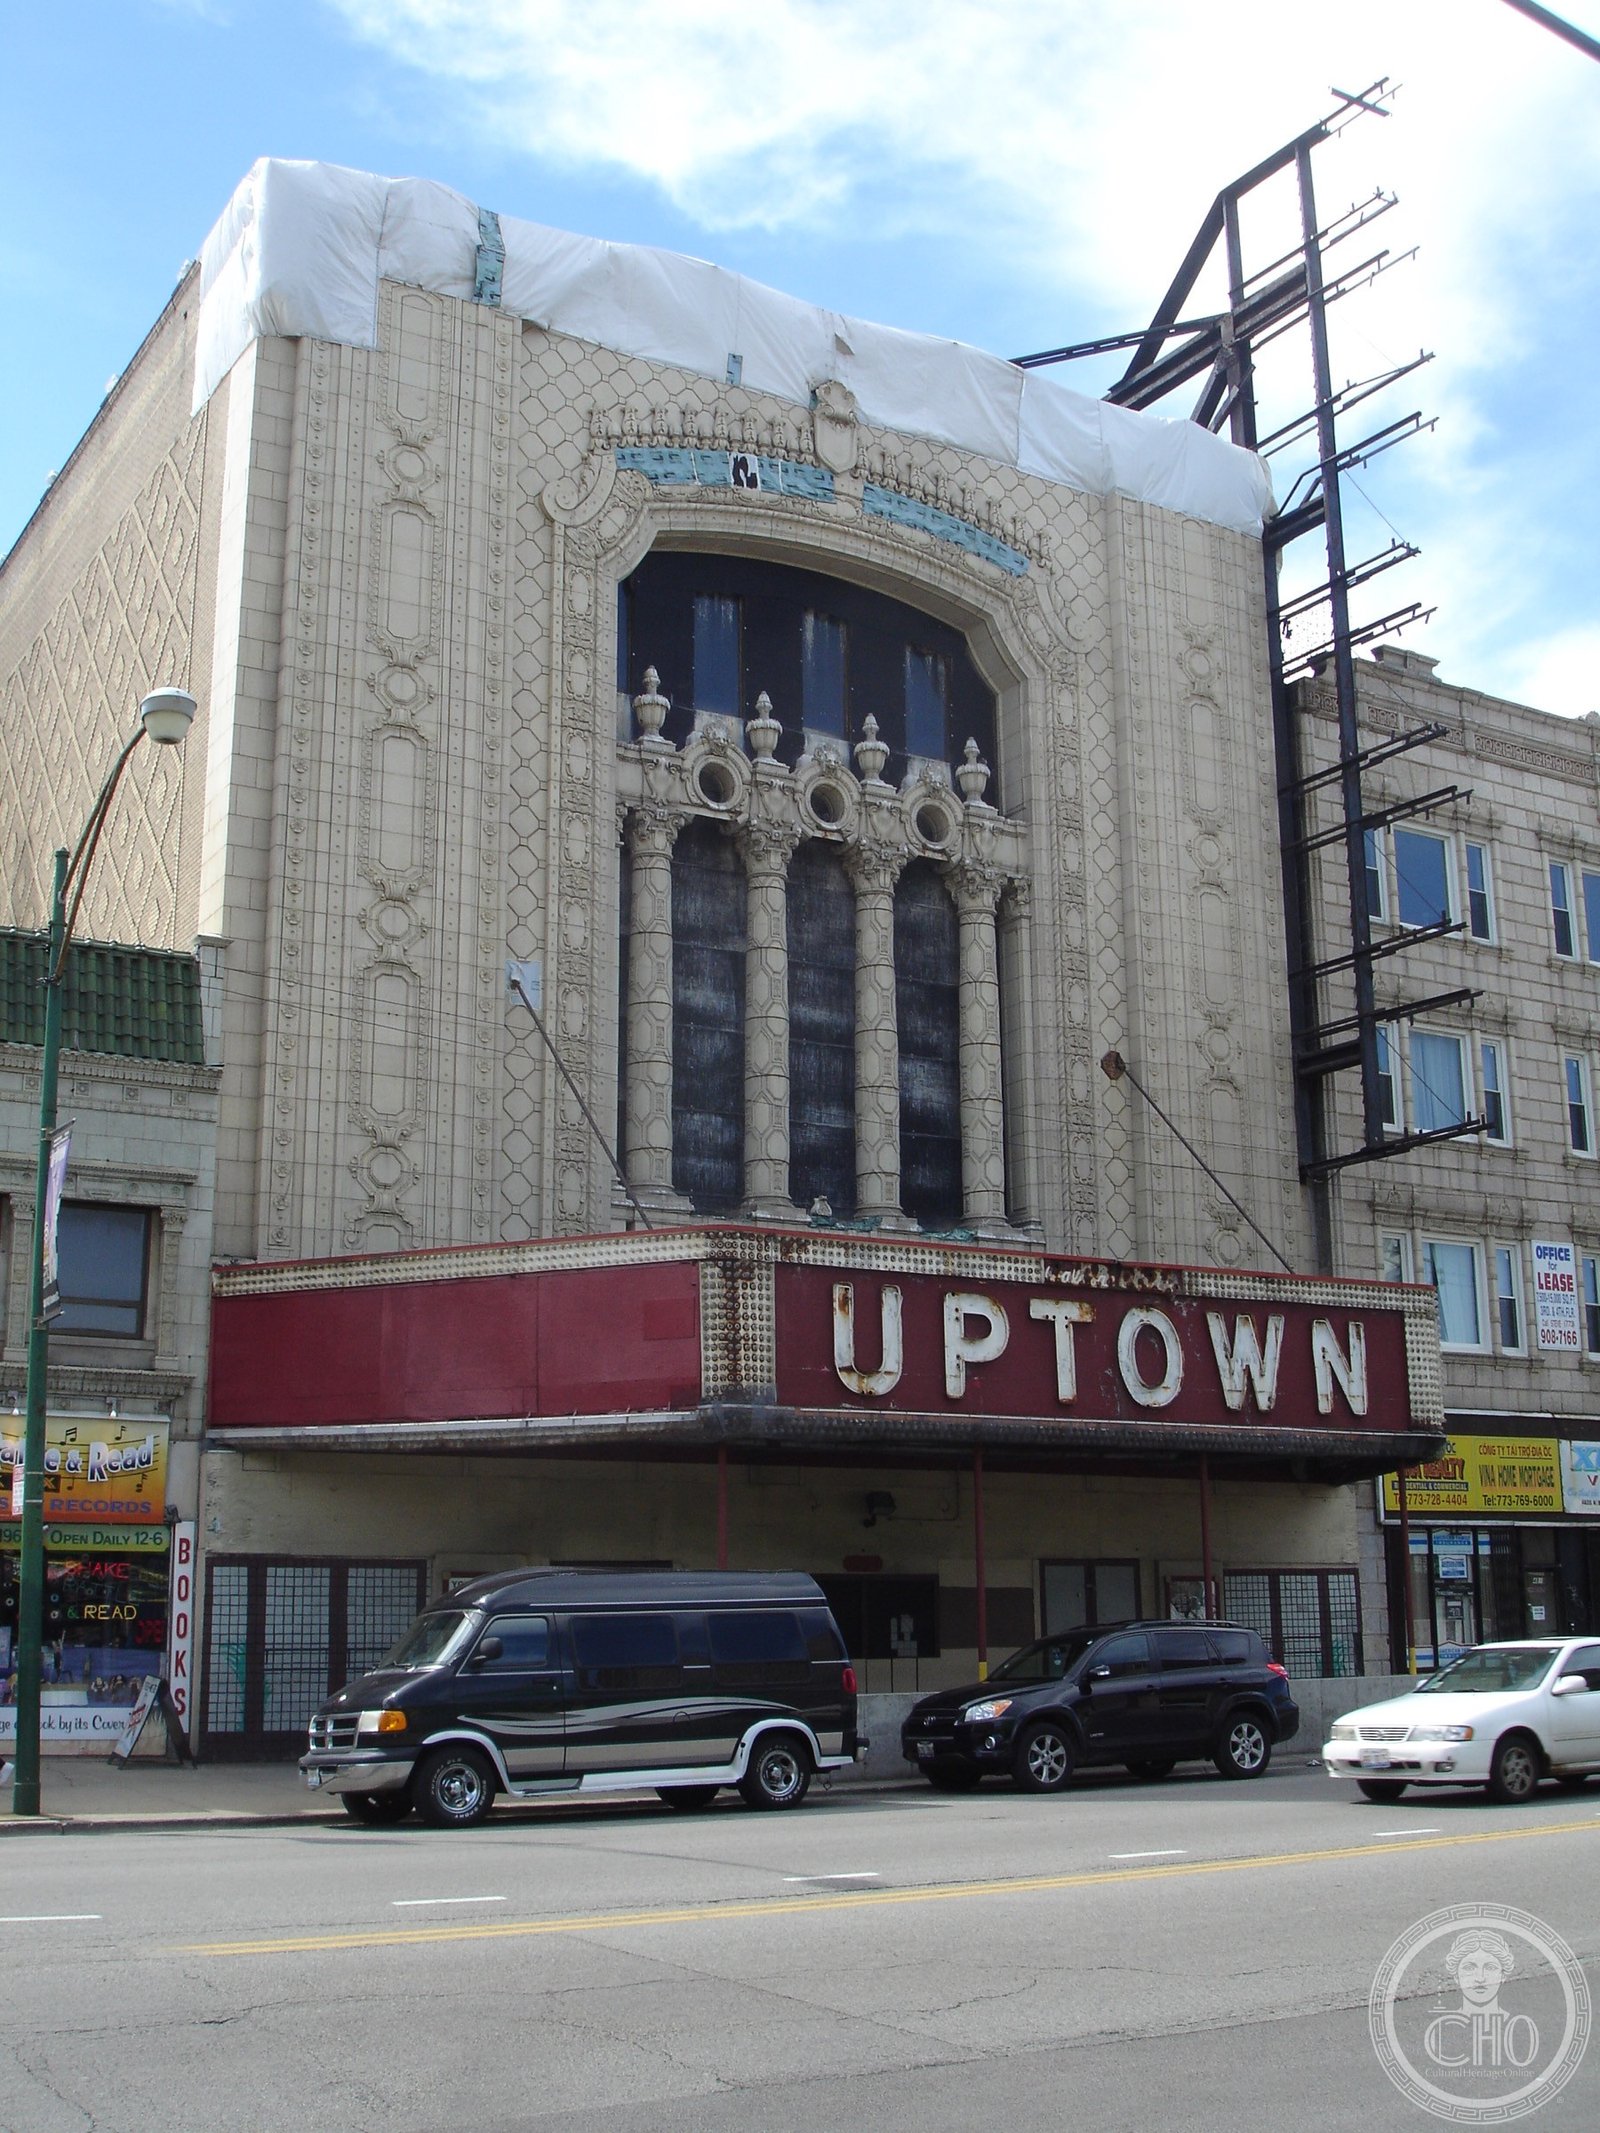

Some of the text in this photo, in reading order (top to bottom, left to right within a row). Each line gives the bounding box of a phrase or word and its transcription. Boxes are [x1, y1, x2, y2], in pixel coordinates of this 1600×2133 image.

[1535, 1245, 1571, 1262] OFFICE
[1547, 1261, 1557, 1271] for
[1537, 1272, 1574, 1292] LEASE
[1540, 1329, 1577, 1345] 908-7166
[832, 1282, 1368, 1416] UPTOWN
[66, 1449, 82, 1473] &
[88, 1435, 154, 1483] Read
[1497, 1464, 1517, 1488] HOME
[1518, 1465, 1555, 1488] MORTGAGE
[1433, 1483, 1467, 1491] COMMERCIAL
[49, 1499, 152, 1513] RECORDS
[134, 1531, 163, 1546] 12-6
[83, 1604, 138, 1620] READ
[174, 1537, 191, 1716] BOOKS
[59, 1715, 73, 1733] by
[75, 1717, 89, 1730] its
[92, 1714, 125, 1730] Cover
